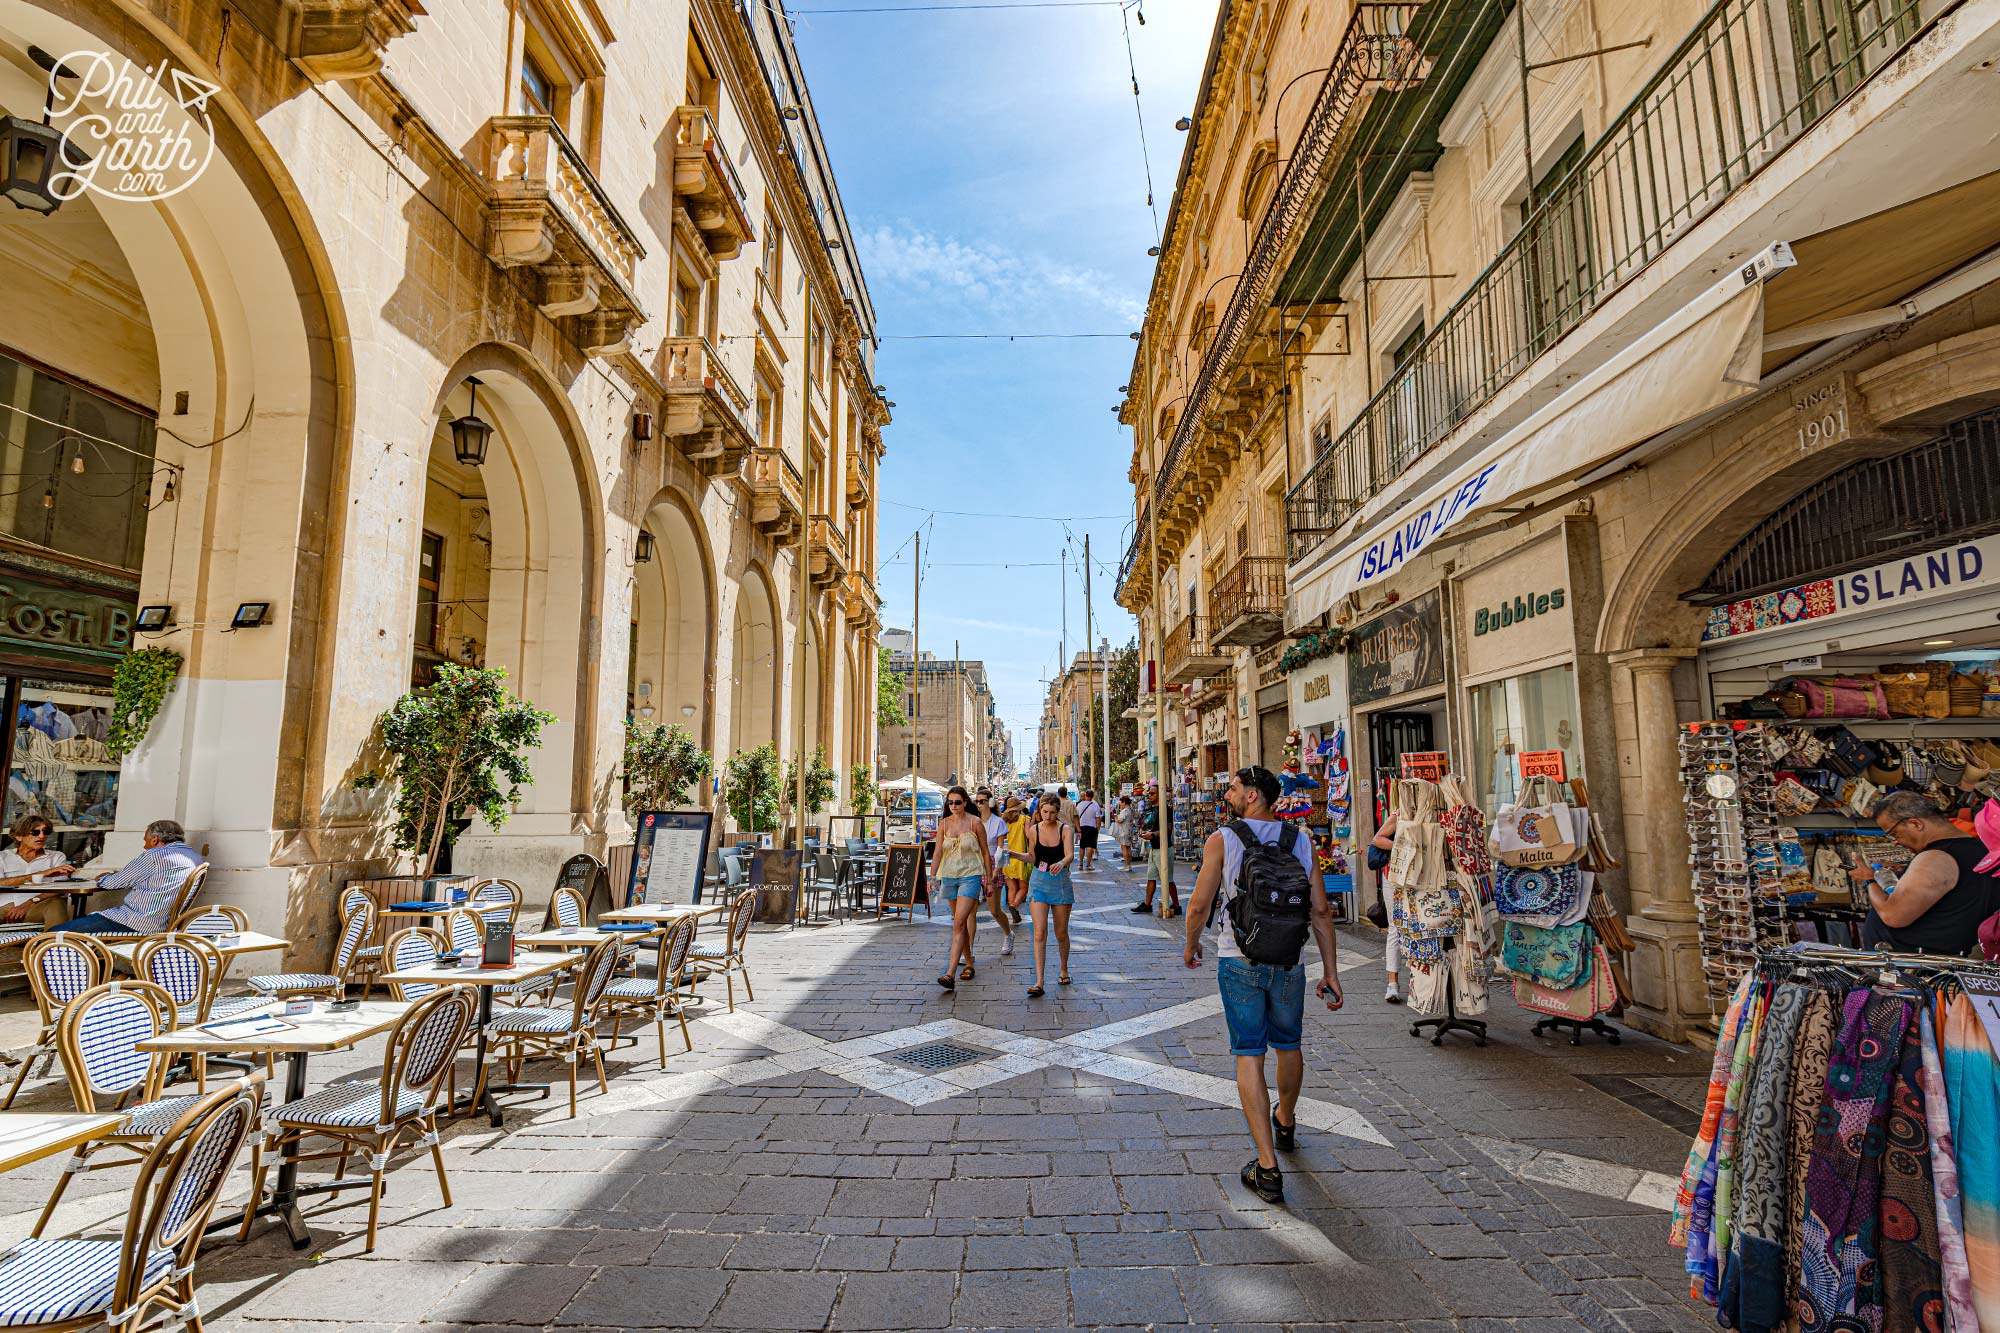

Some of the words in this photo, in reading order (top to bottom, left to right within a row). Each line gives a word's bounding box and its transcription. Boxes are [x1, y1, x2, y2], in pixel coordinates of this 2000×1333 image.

[1796, 382, 1840, 411] SINCE
[1798, 409, 1849, 450] 1901
[1357, 510, 1432, 582] ISLAND
[1431, 463, 1498, 536] LIFE
[1838, 545, 1983, 609] ISLAND
[1474, 587, 1566, 637] Bubbles
[1361, 618, 1419, 669] BUBBLES
[1527, 765, 1557, 776] €999
[896, 851, 912, 864] Pint
[1519, 850, 1554, 864] Malta
[898, 864, 907, 878] of
[1512, 940, 1539, 952] MALTA
[1530, 994, 1570, 1011] Malta
